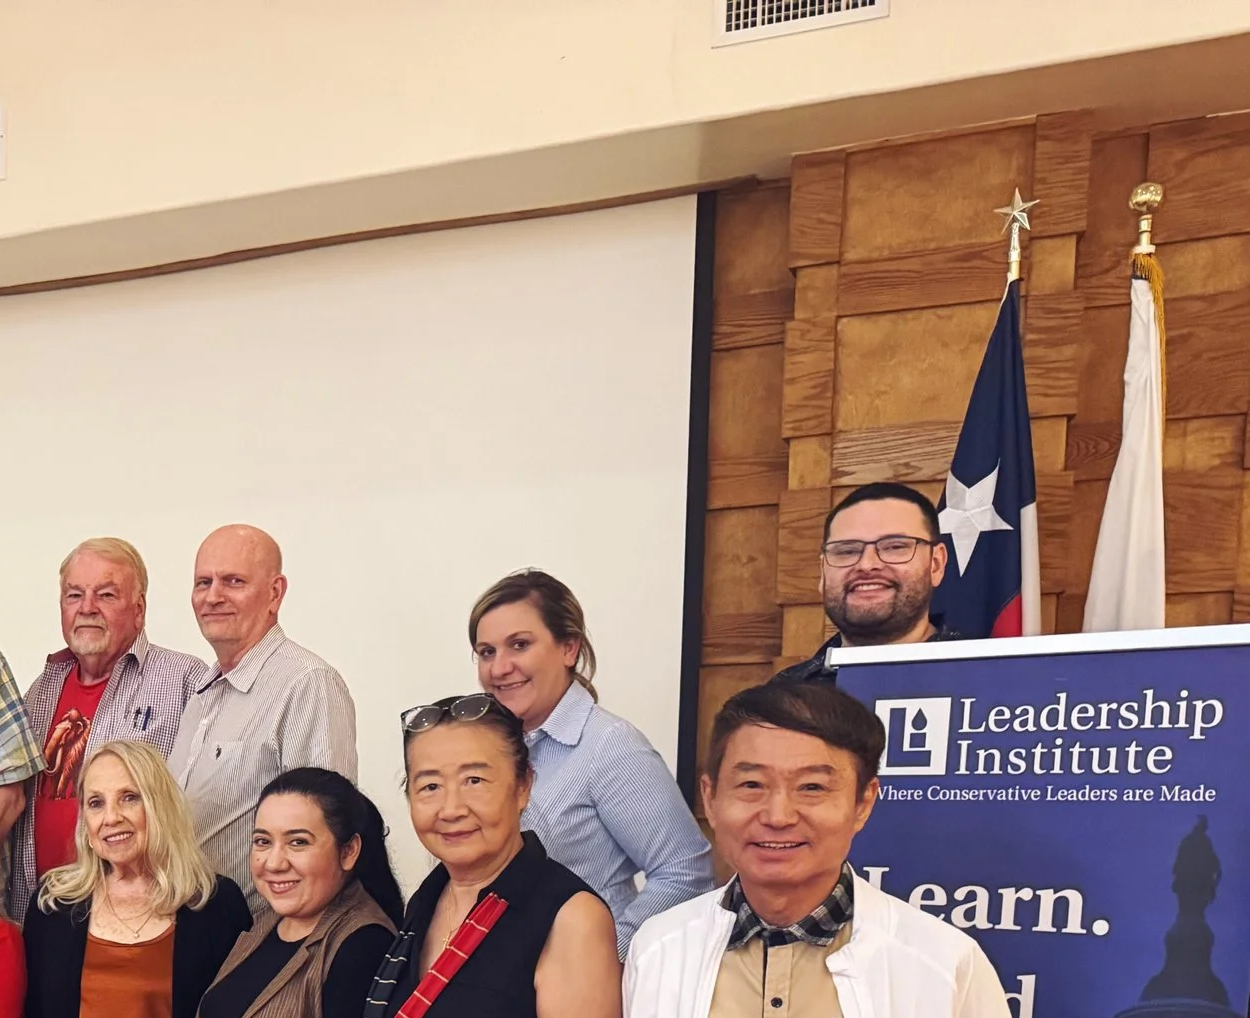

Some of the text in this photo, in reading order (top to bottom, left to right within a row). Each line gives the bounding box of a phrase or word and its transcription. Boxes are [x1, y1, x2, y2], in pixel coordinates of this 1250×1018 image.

[957, 688, 1224, 740] Leadership
[954, 737, 1173, 776] Institute
[927, 785, 1041, 801] Conservative
[1046, 784, 1118, 801] Leaders
[1123, 787, 1154, 801] are
[1160, 784, 1217, 801] Made
